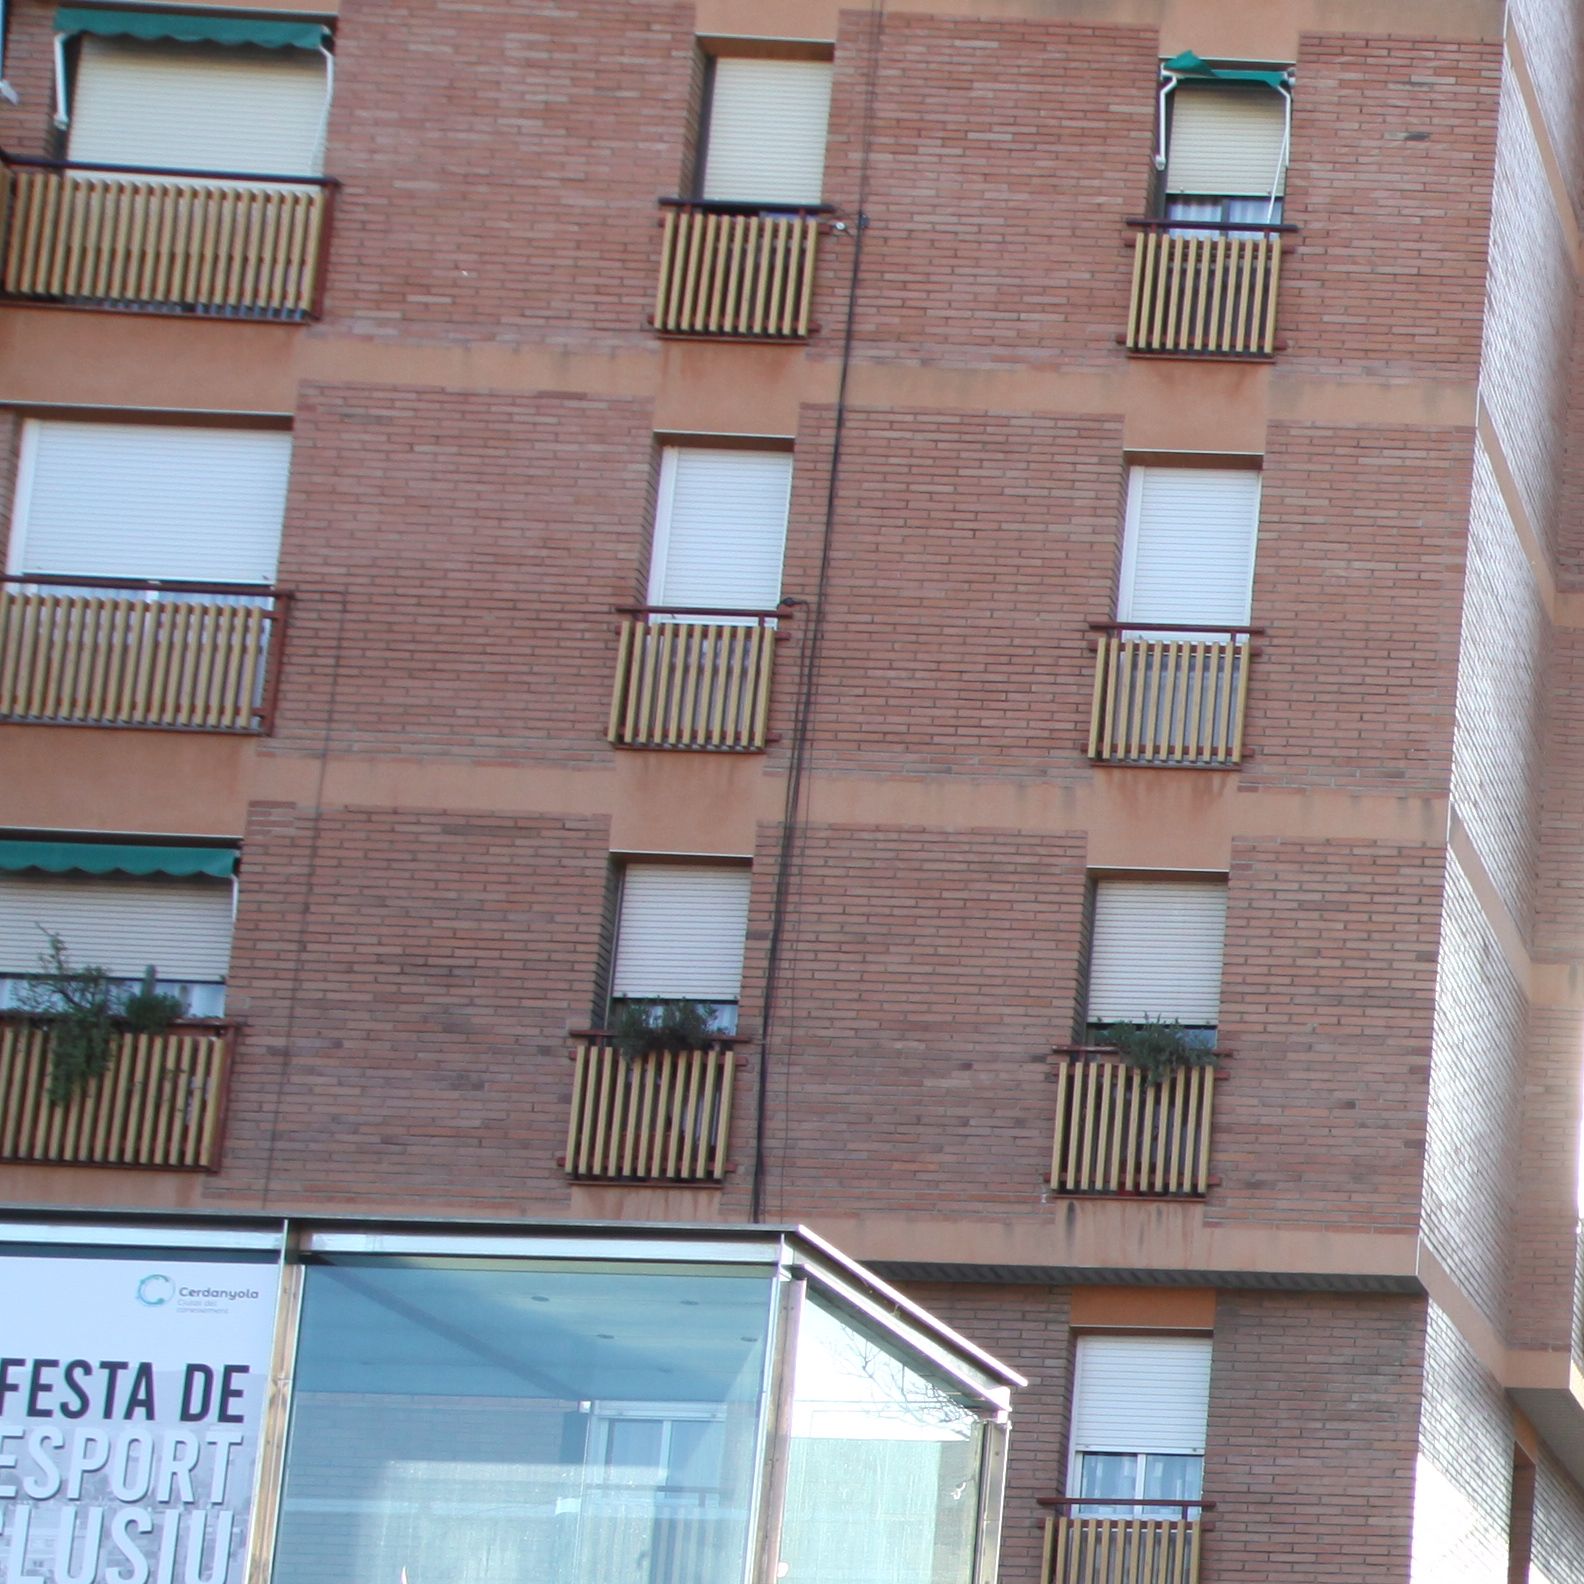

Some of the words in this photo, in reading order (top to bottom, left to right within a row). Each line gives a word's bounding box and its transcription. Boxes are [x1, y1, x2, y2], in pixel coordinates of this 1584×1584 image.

[178, 1287, 259, 1300] Cerdanyola
[0, 1357, 156, 1421] FESTA
[180, 1363, 250, 1423] DE
